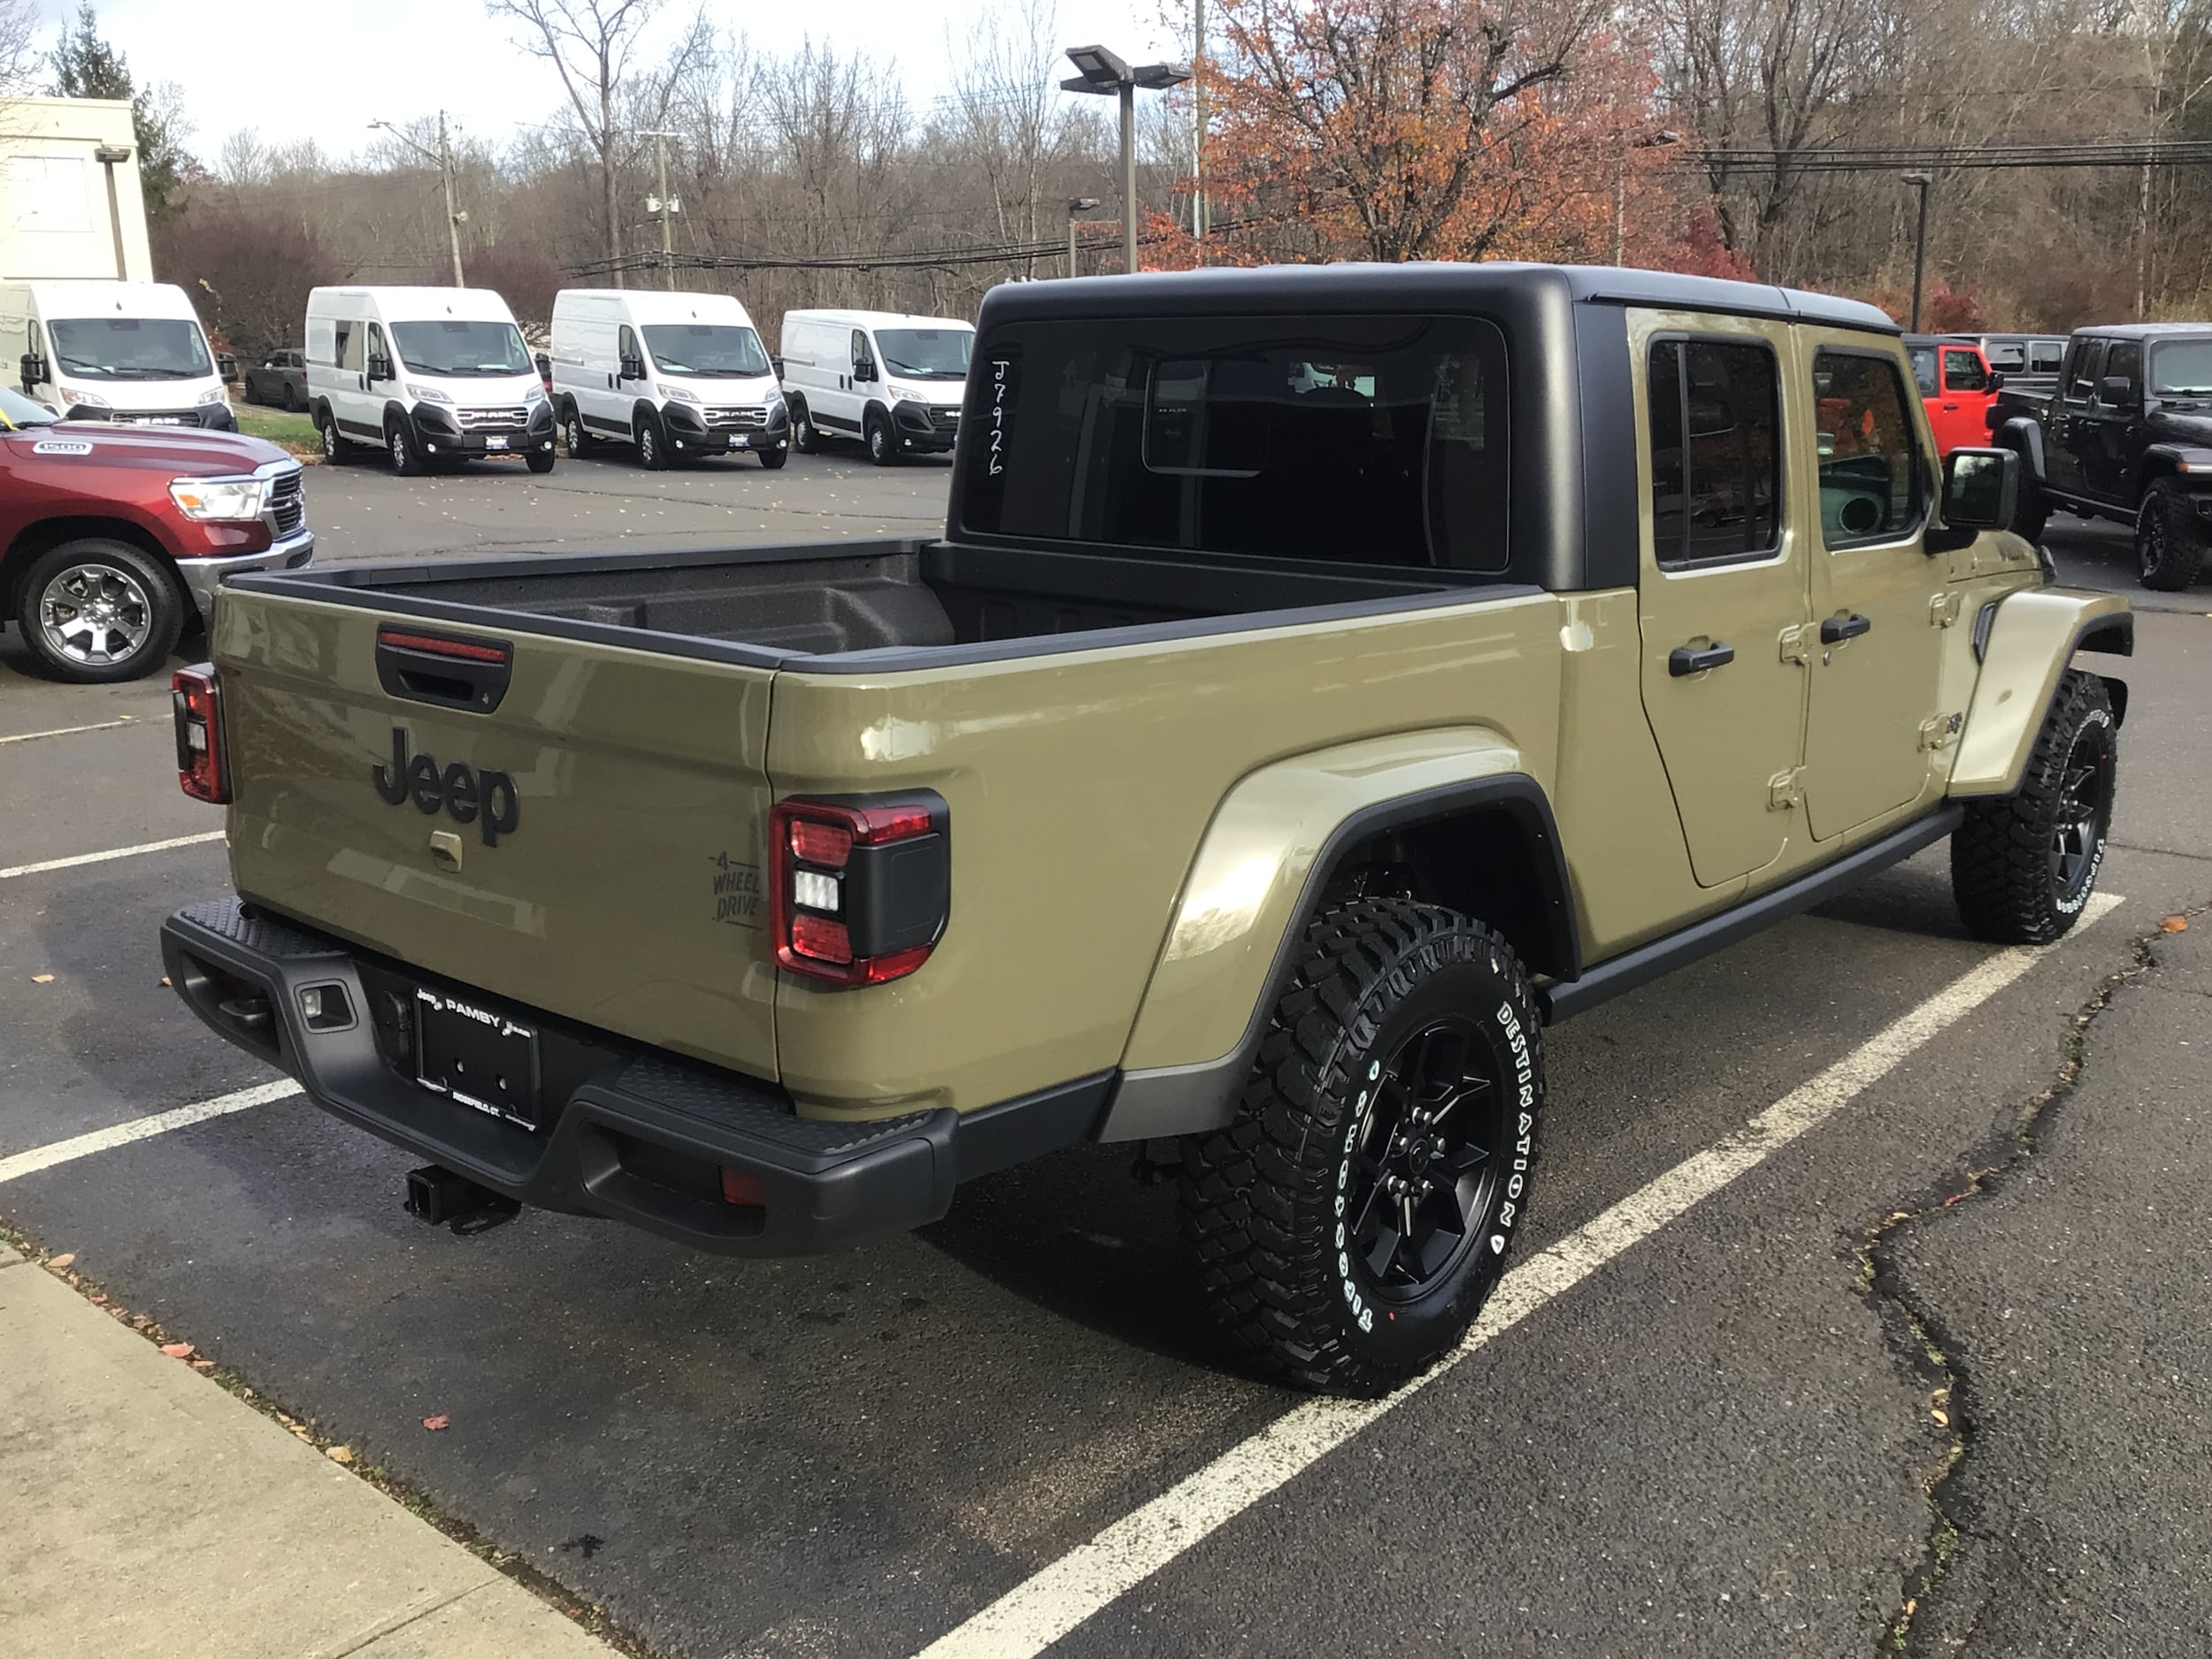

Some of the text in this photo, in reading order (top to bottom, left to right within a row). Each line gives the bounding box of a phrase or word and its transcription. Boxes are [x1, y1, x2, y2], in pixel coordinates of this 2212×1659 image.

[989, 360, 1010, 476] J7926
[373, 726, 520, 849] Jeep
[717, 850, 729, 871] 4
[713, 872, 760, 895] WHEEL
[716, 895, 759, 922] DRIVE
[445, 998, 501, 1027] PAMBY
[1496, 1001, 1534, 1227] DESTINATION
